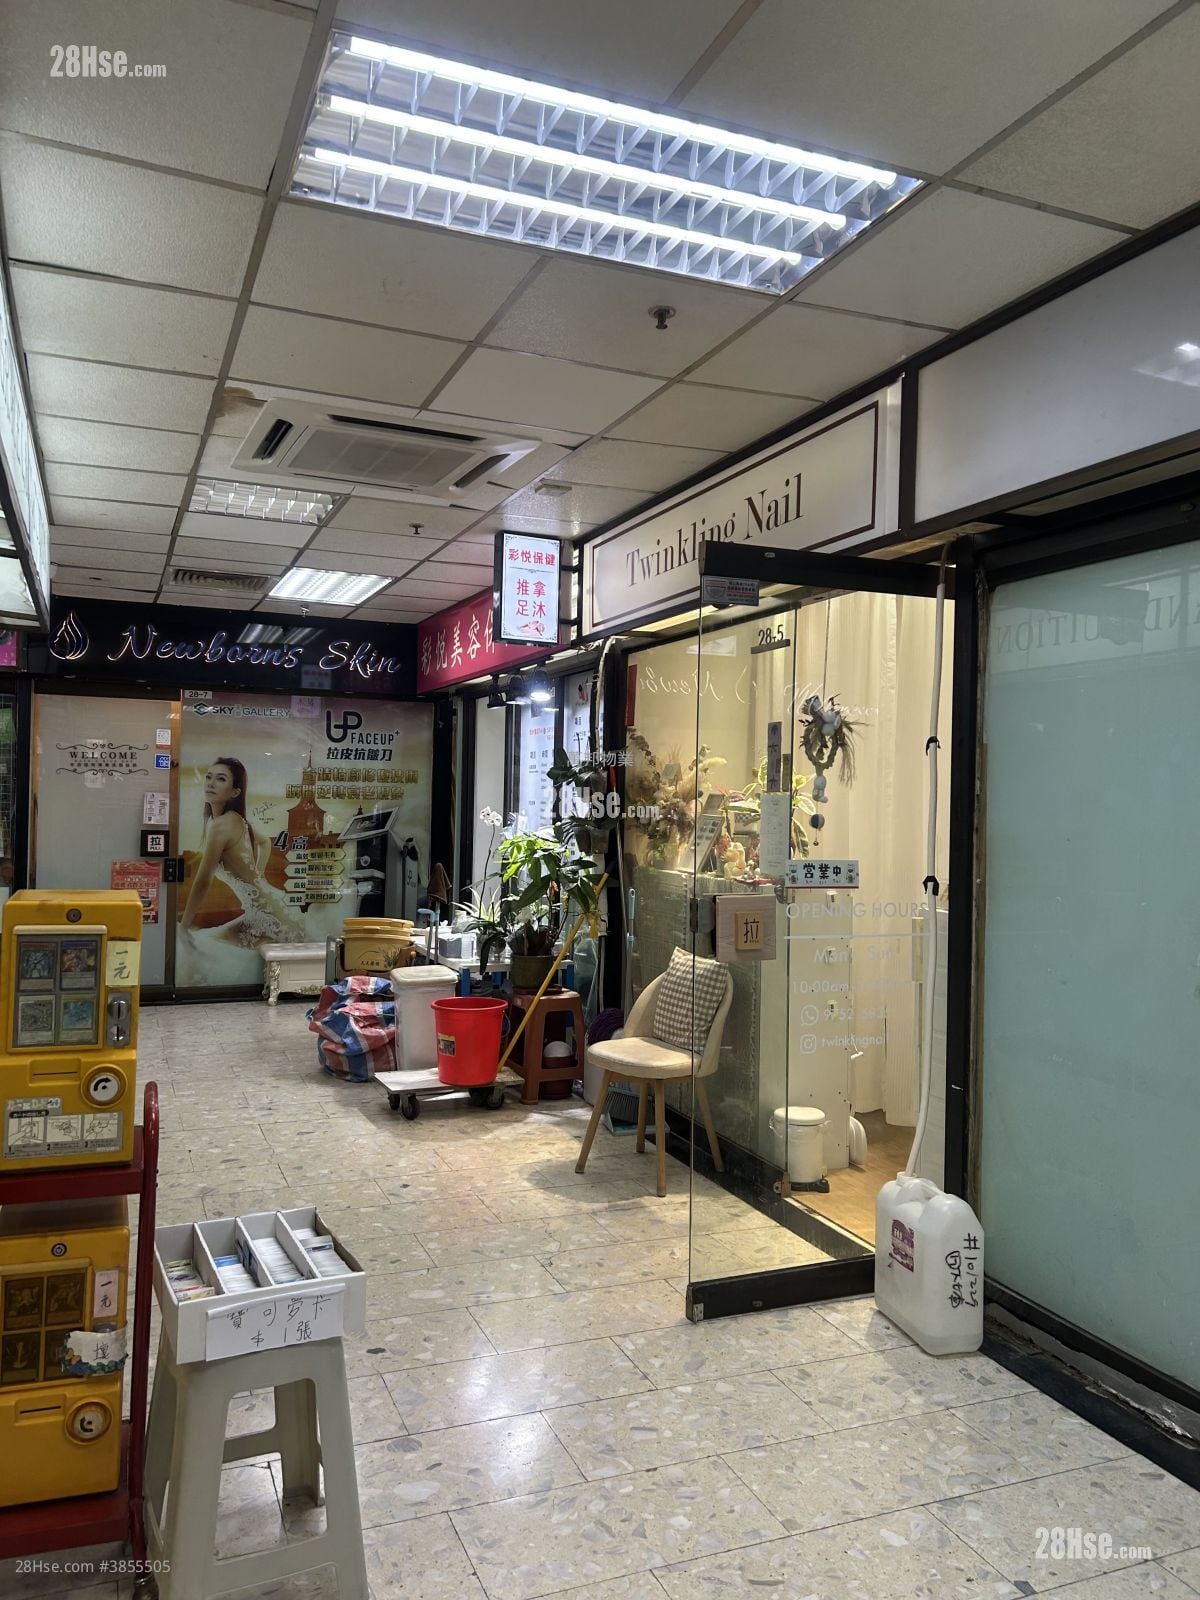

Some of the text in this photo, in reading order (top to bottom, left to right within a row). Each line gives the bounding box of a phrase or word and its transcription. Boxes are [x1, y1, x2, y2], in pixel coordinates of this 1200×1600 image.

[743, 472, 804, 540] Nail
[516, 578, 546, 598] 推拿
[516, 599, 546, 618] 足沐
[319, 639, 402, 679] Skin
[188, 690, 208, 698] 28-7
[212, 705, 291, 717] SKY GALLERY
[69, 751, 138, 760] WELCOME
[149, 835, 162, 846] 拉
[802, 862, 842, 880] 營業中
[785, 901, 930, 920] OPENING HOURS
[743, 918, 760, 944] 拉
[113, 949, 132, 980] 一元
[100, 1280, 113, 1308] 一元
